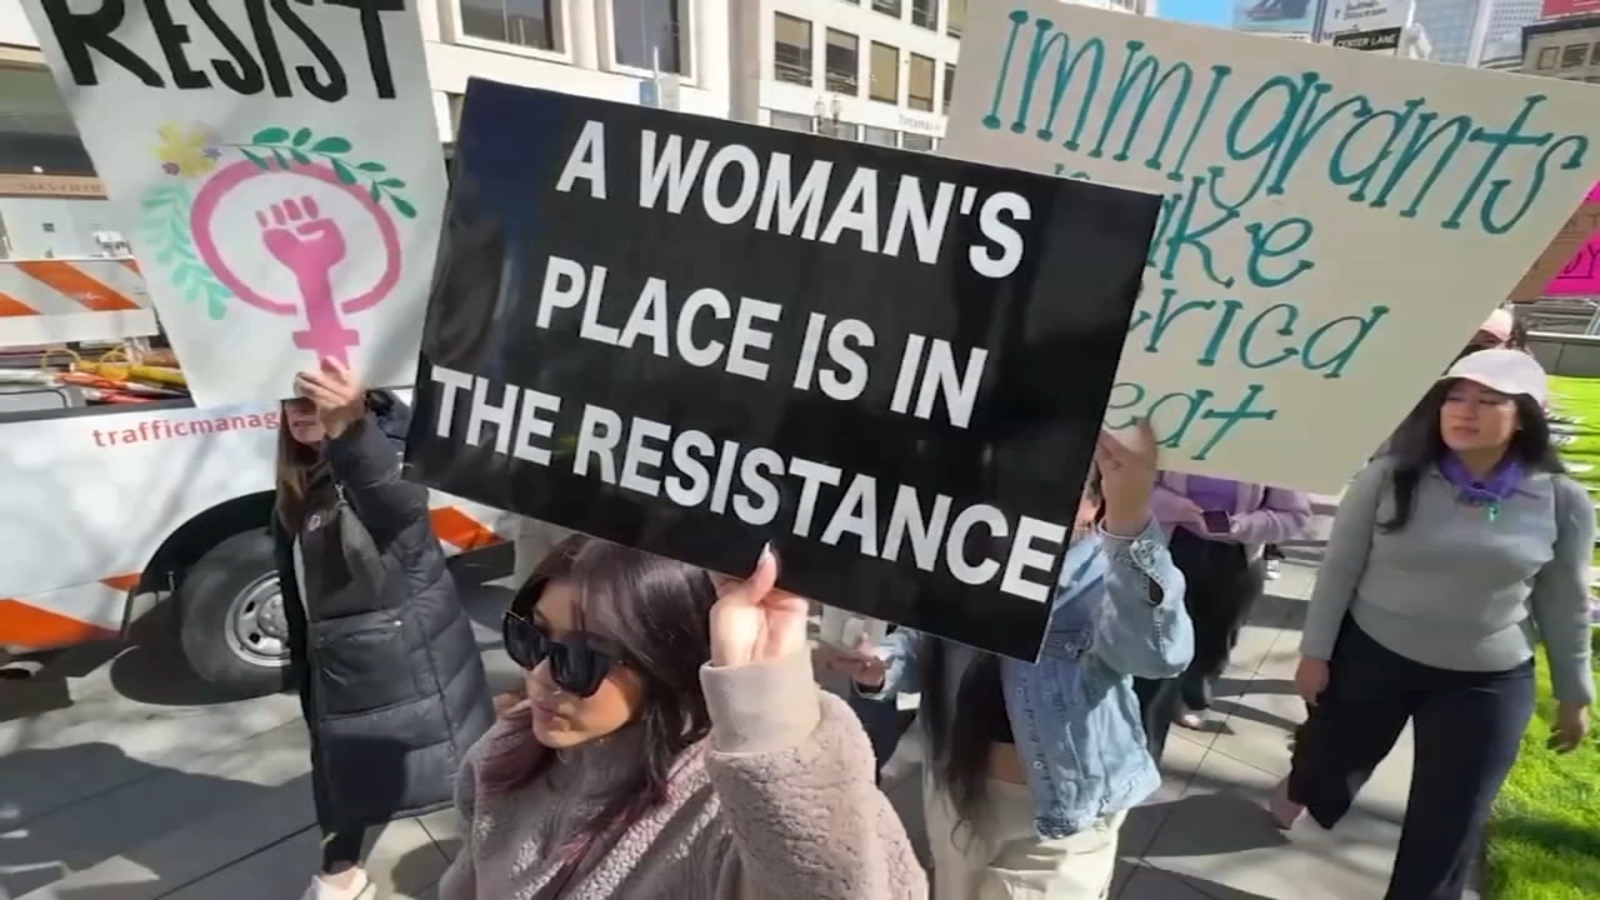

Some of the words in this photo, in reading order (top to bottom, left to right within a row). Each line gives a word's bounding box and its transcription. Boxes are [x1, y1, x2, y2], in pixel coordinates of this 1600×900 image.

[41, 0, 405, 102] RESIST
[1369, 33, 1396, 46] LANE
[982, 10, 1589, 233] Immigrants
[555, 120, 606, 200] A
[639, 129, 1031, 278] WOMAN'S
[536, 255, 782, 381] PLACE
[793, 312, 875, 401] IS
[890, 333, 989, 429] IN
[1128, 288, 1390, 380] rica
[92, 411, 280, 447] trafficmanag
[1102, 381, 1278, 461] eat
[431, 364, 562, 466] THE
[573, 403, 1067, 603] RESISTANCE
